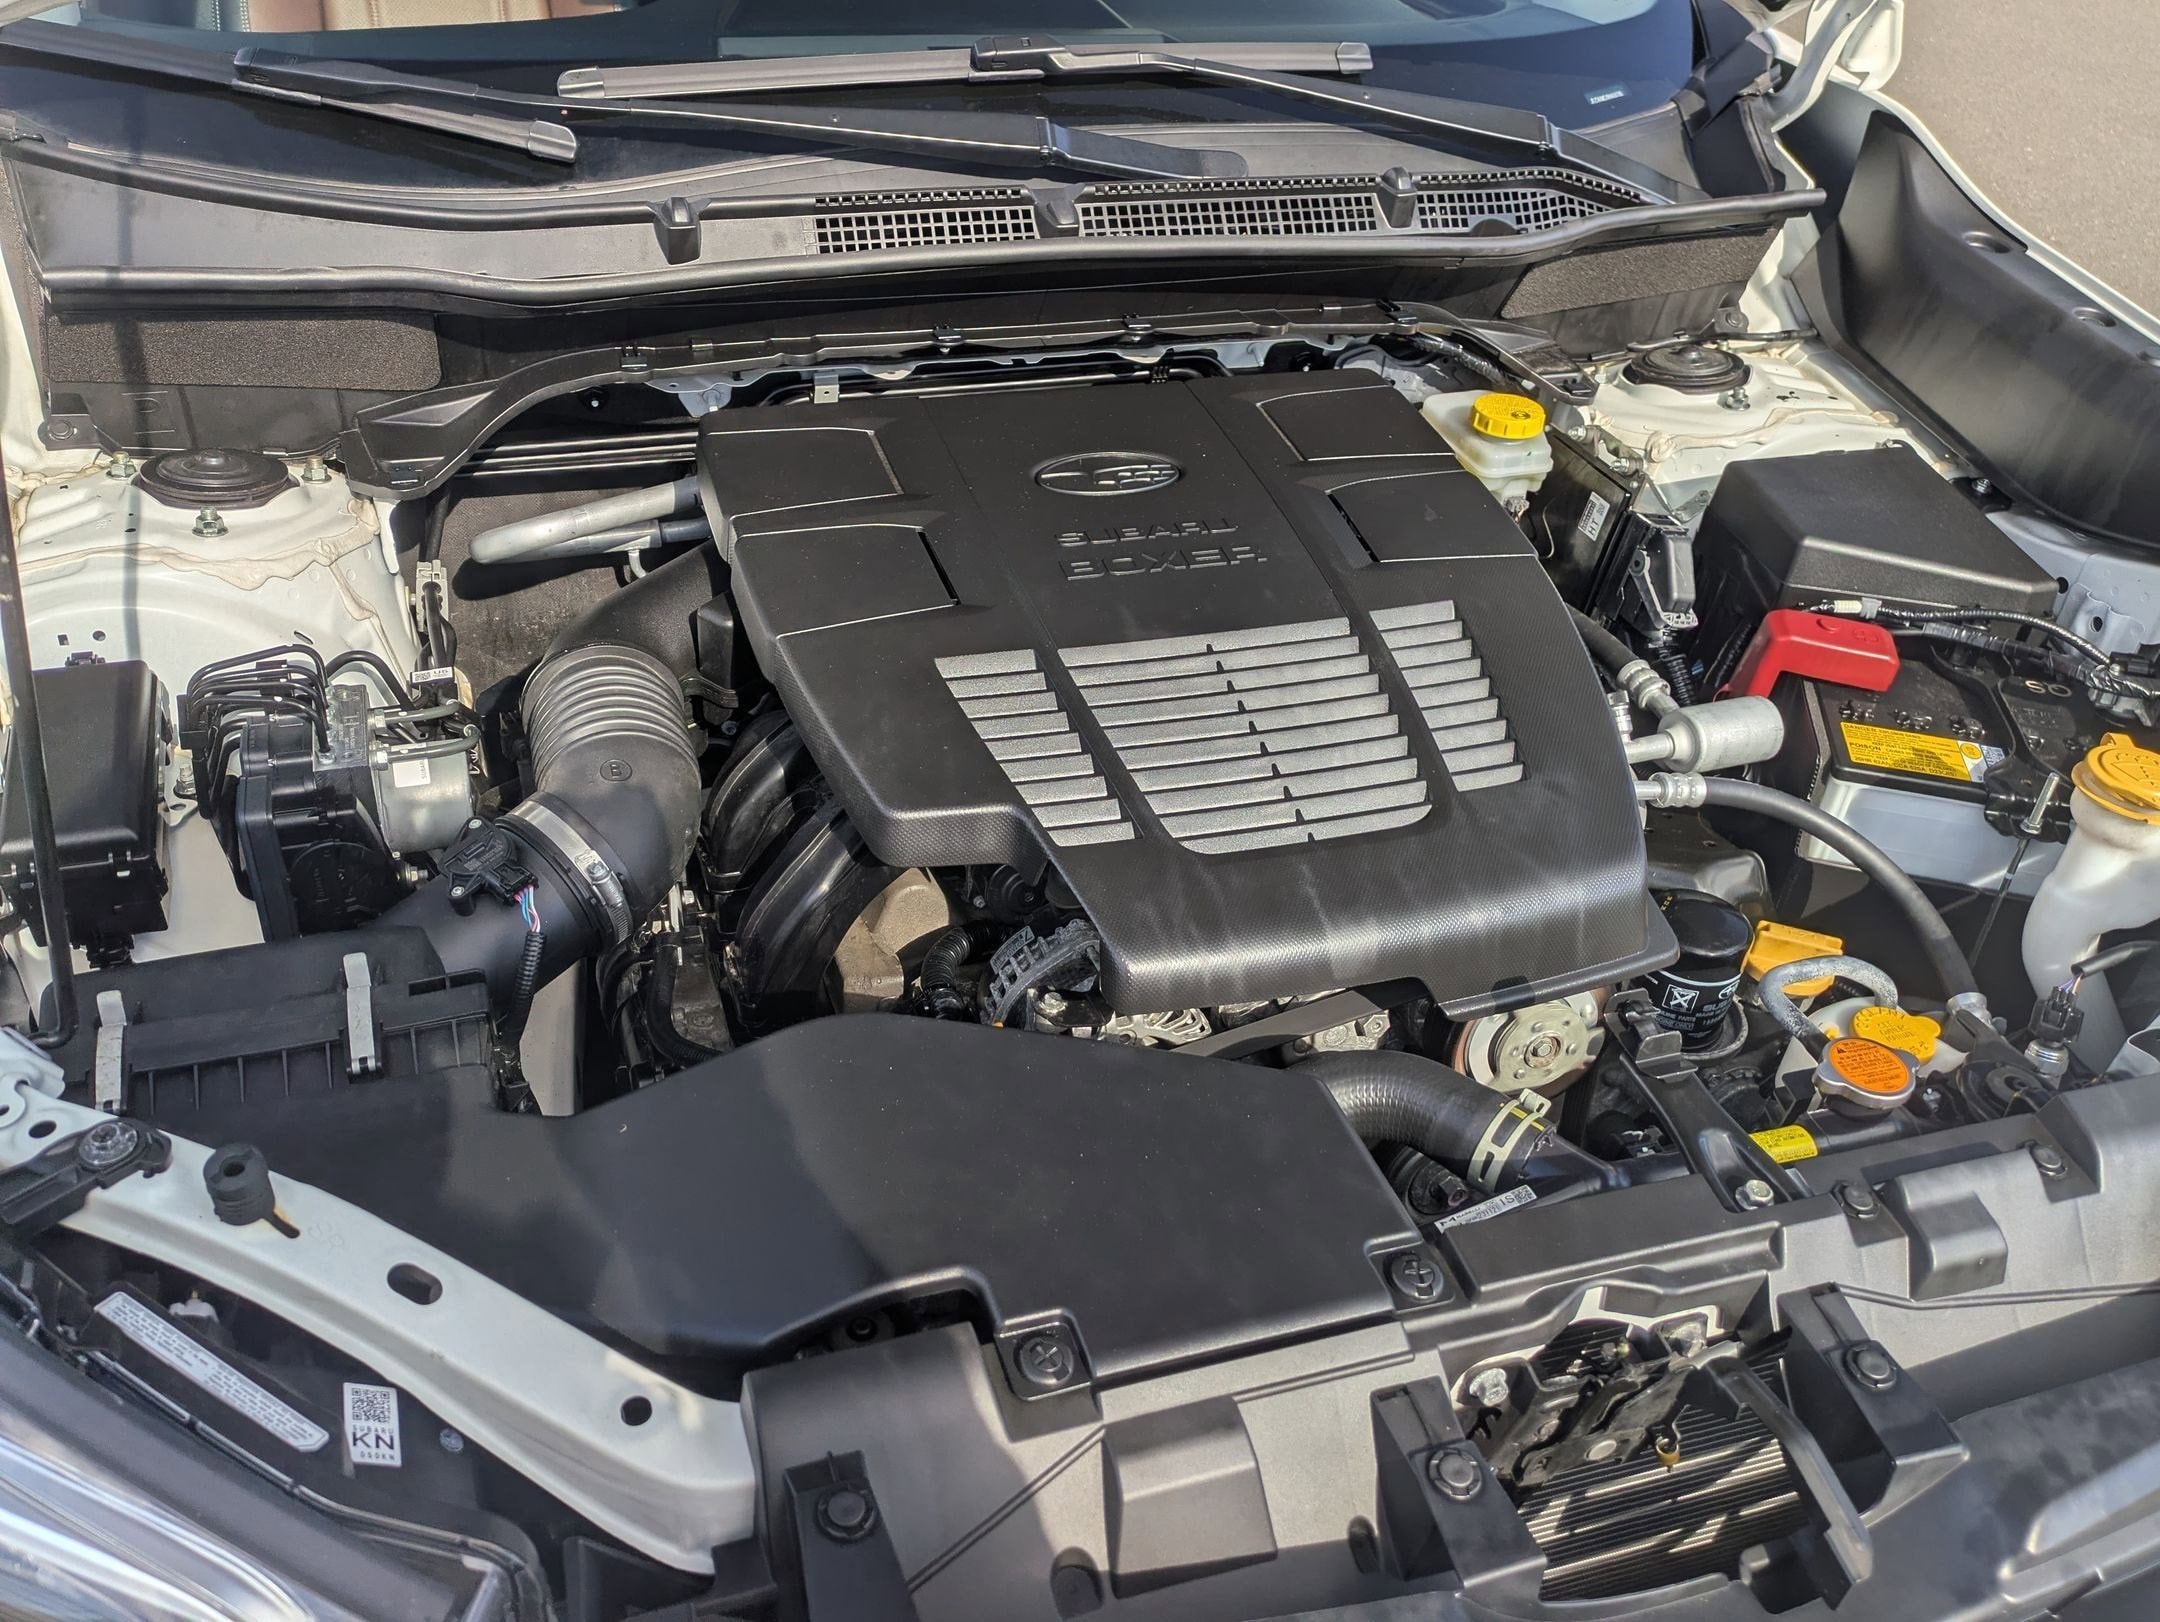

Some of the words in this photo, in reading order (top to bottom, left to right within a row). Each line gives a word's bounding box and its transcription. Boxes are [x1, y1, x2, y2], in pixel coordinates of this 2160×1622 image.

[1054, 518, 1239, 547] SUBARU
[1058, 546, 1268, 581] BOXER
[1844, 723, 1877, 733] DANGER
[1850, 742, 1881, 751] POISON
[352, 1424, 394, 1434] SUBARU
[353, 1432, 394, 1450] KN
